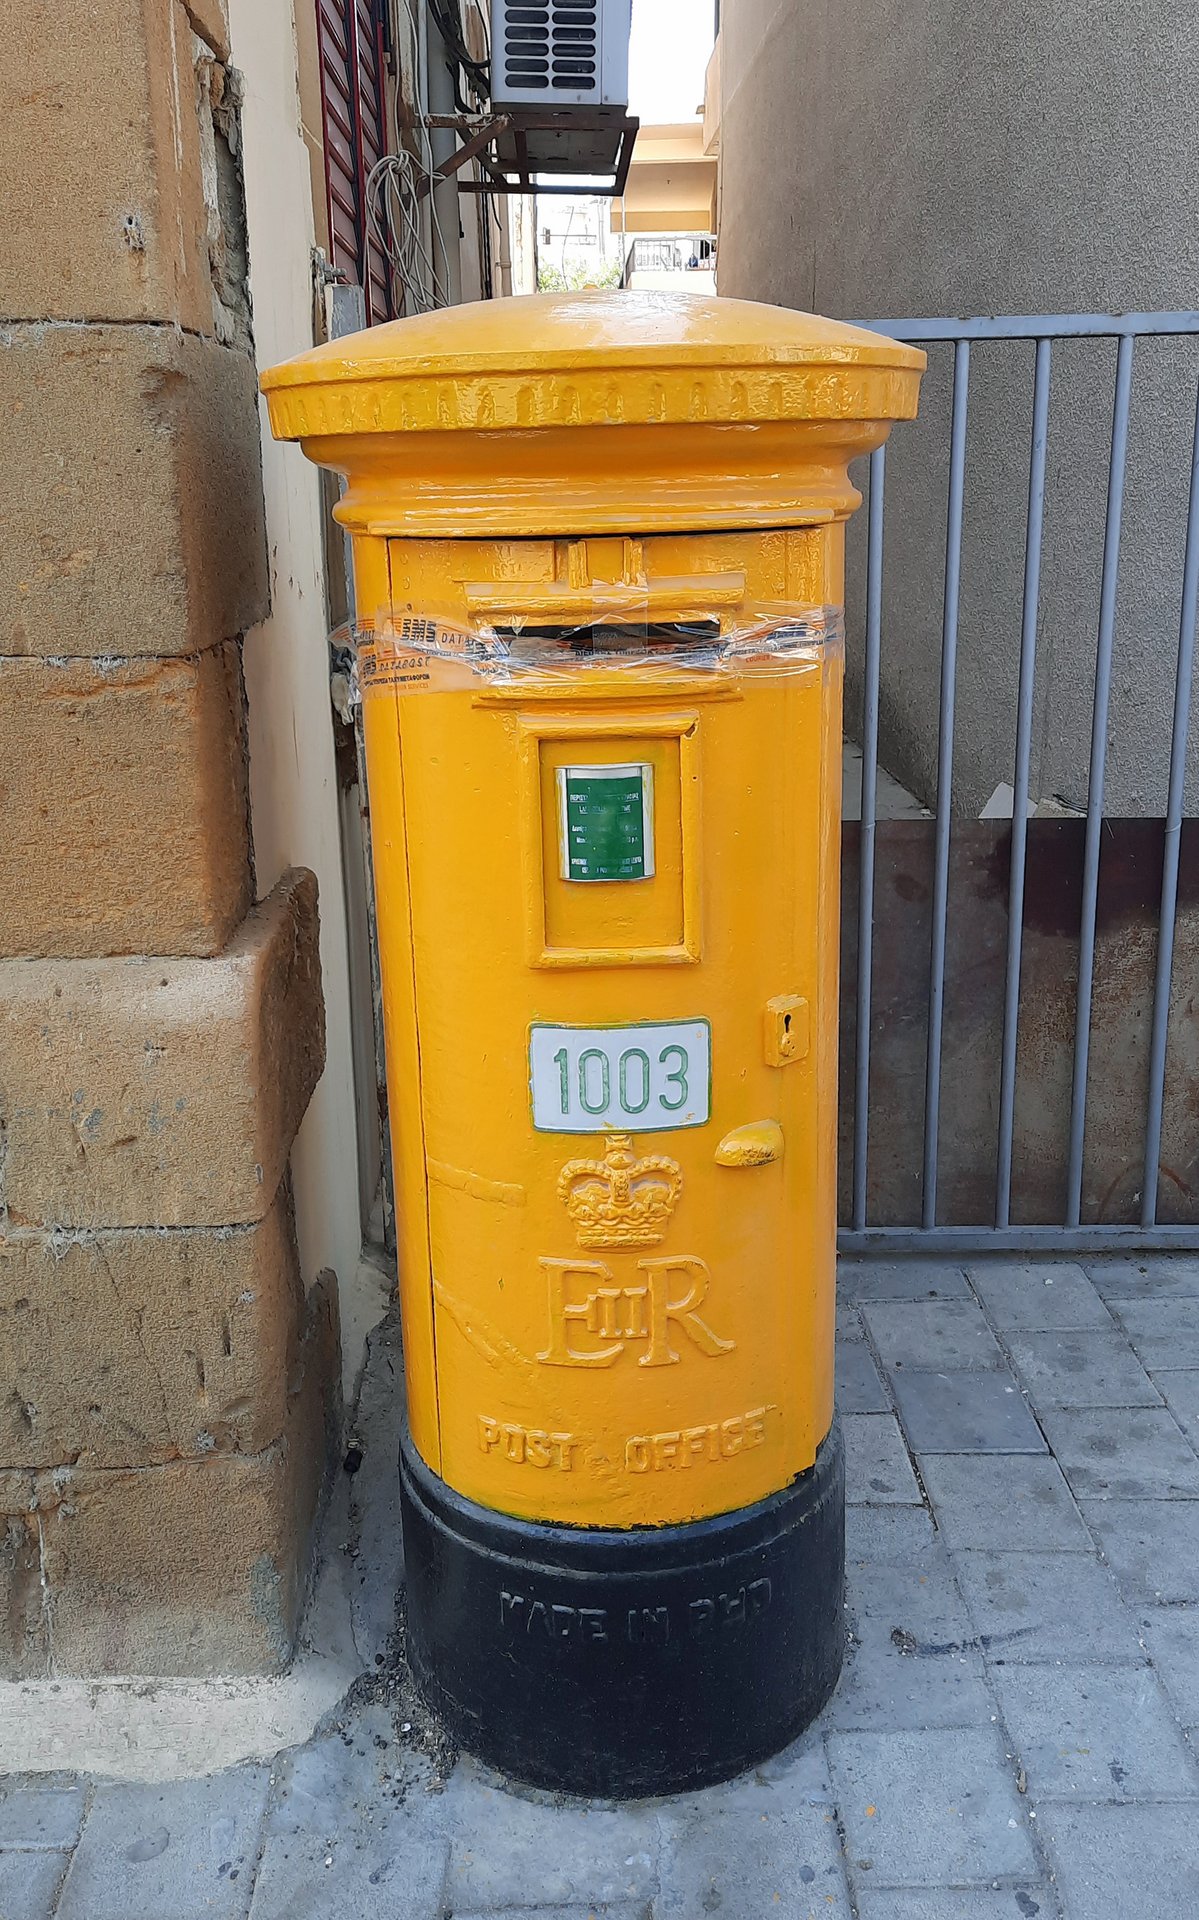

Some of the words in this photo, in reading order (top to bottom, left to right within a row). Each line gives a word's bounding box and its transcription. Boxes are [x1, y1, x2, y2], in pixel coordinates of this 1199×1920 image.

[554, 1044, 689, 1114] 1003
[478, 1414, 574, 1471] POST
[625, 1404, 774, 1473] OFFICE
